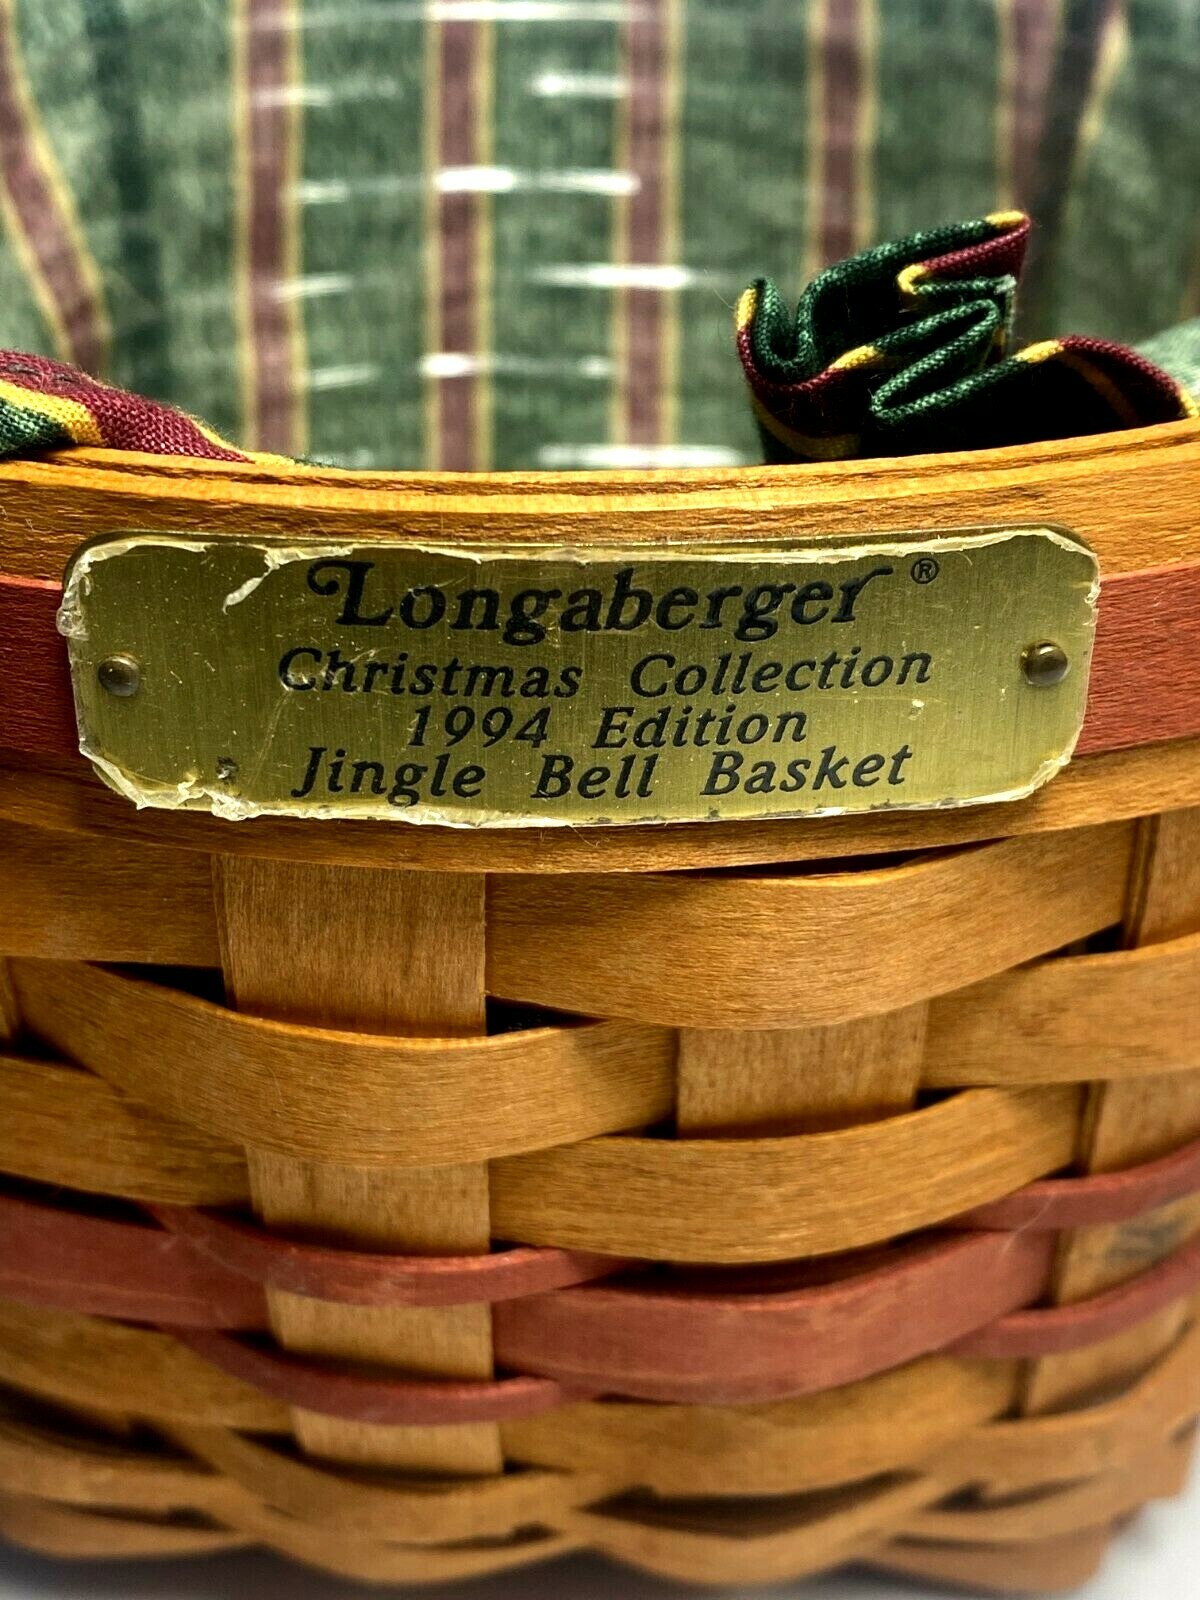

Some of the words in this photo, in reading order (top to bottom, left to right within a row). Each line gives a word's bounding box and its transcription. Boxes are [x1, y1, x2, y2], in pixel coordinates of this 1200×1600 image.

[307, 560, 894, 646] Longaberger
[278, 647, 583, 699] Christmas
[629, 646, 933, 698] Collection
[407, 704, 552, 749] 1994
[591, 703, 808, 749] Edition
[290, 746, 486, 808] Jingle
[530, 753, 660, 800] Bell
[699, 744, 913, 796] Basket
